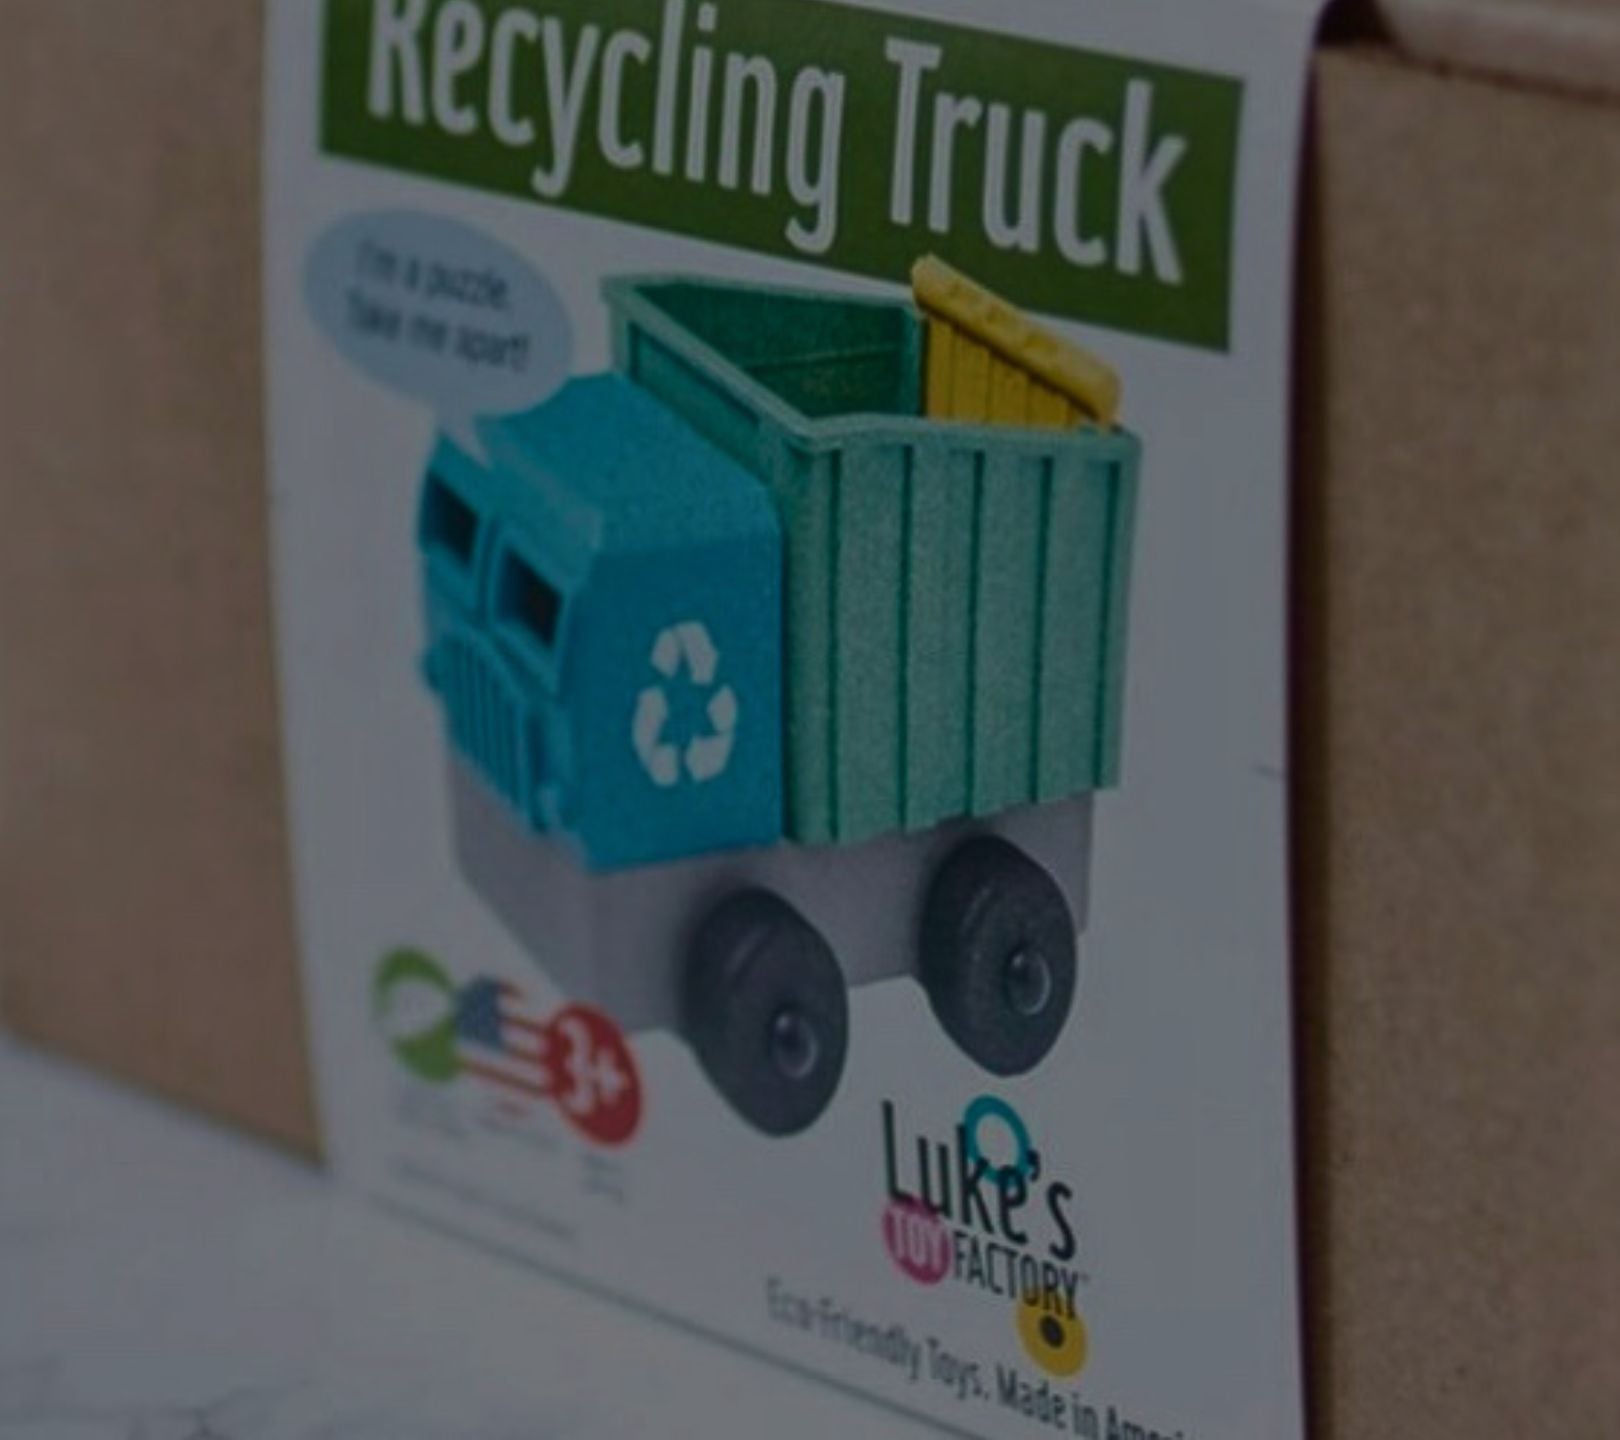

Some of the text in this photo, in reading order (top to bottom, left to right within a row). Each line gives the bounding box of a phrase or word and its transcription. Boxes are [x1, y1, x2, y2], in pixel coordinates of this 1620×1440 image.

[884, 37, 1187, 287] Truck
[558, 1016, 629, 1113] 3+
[882, 1100, 1076, 1261] Luke's
[890, 1208, 1079, 1319] TOY FACTORY
[767, 1277, 922, 1383] Eco-Friendly
[996, 1365, 1066, 1430] Made
[1072, 1392, 1099, 1440] in
